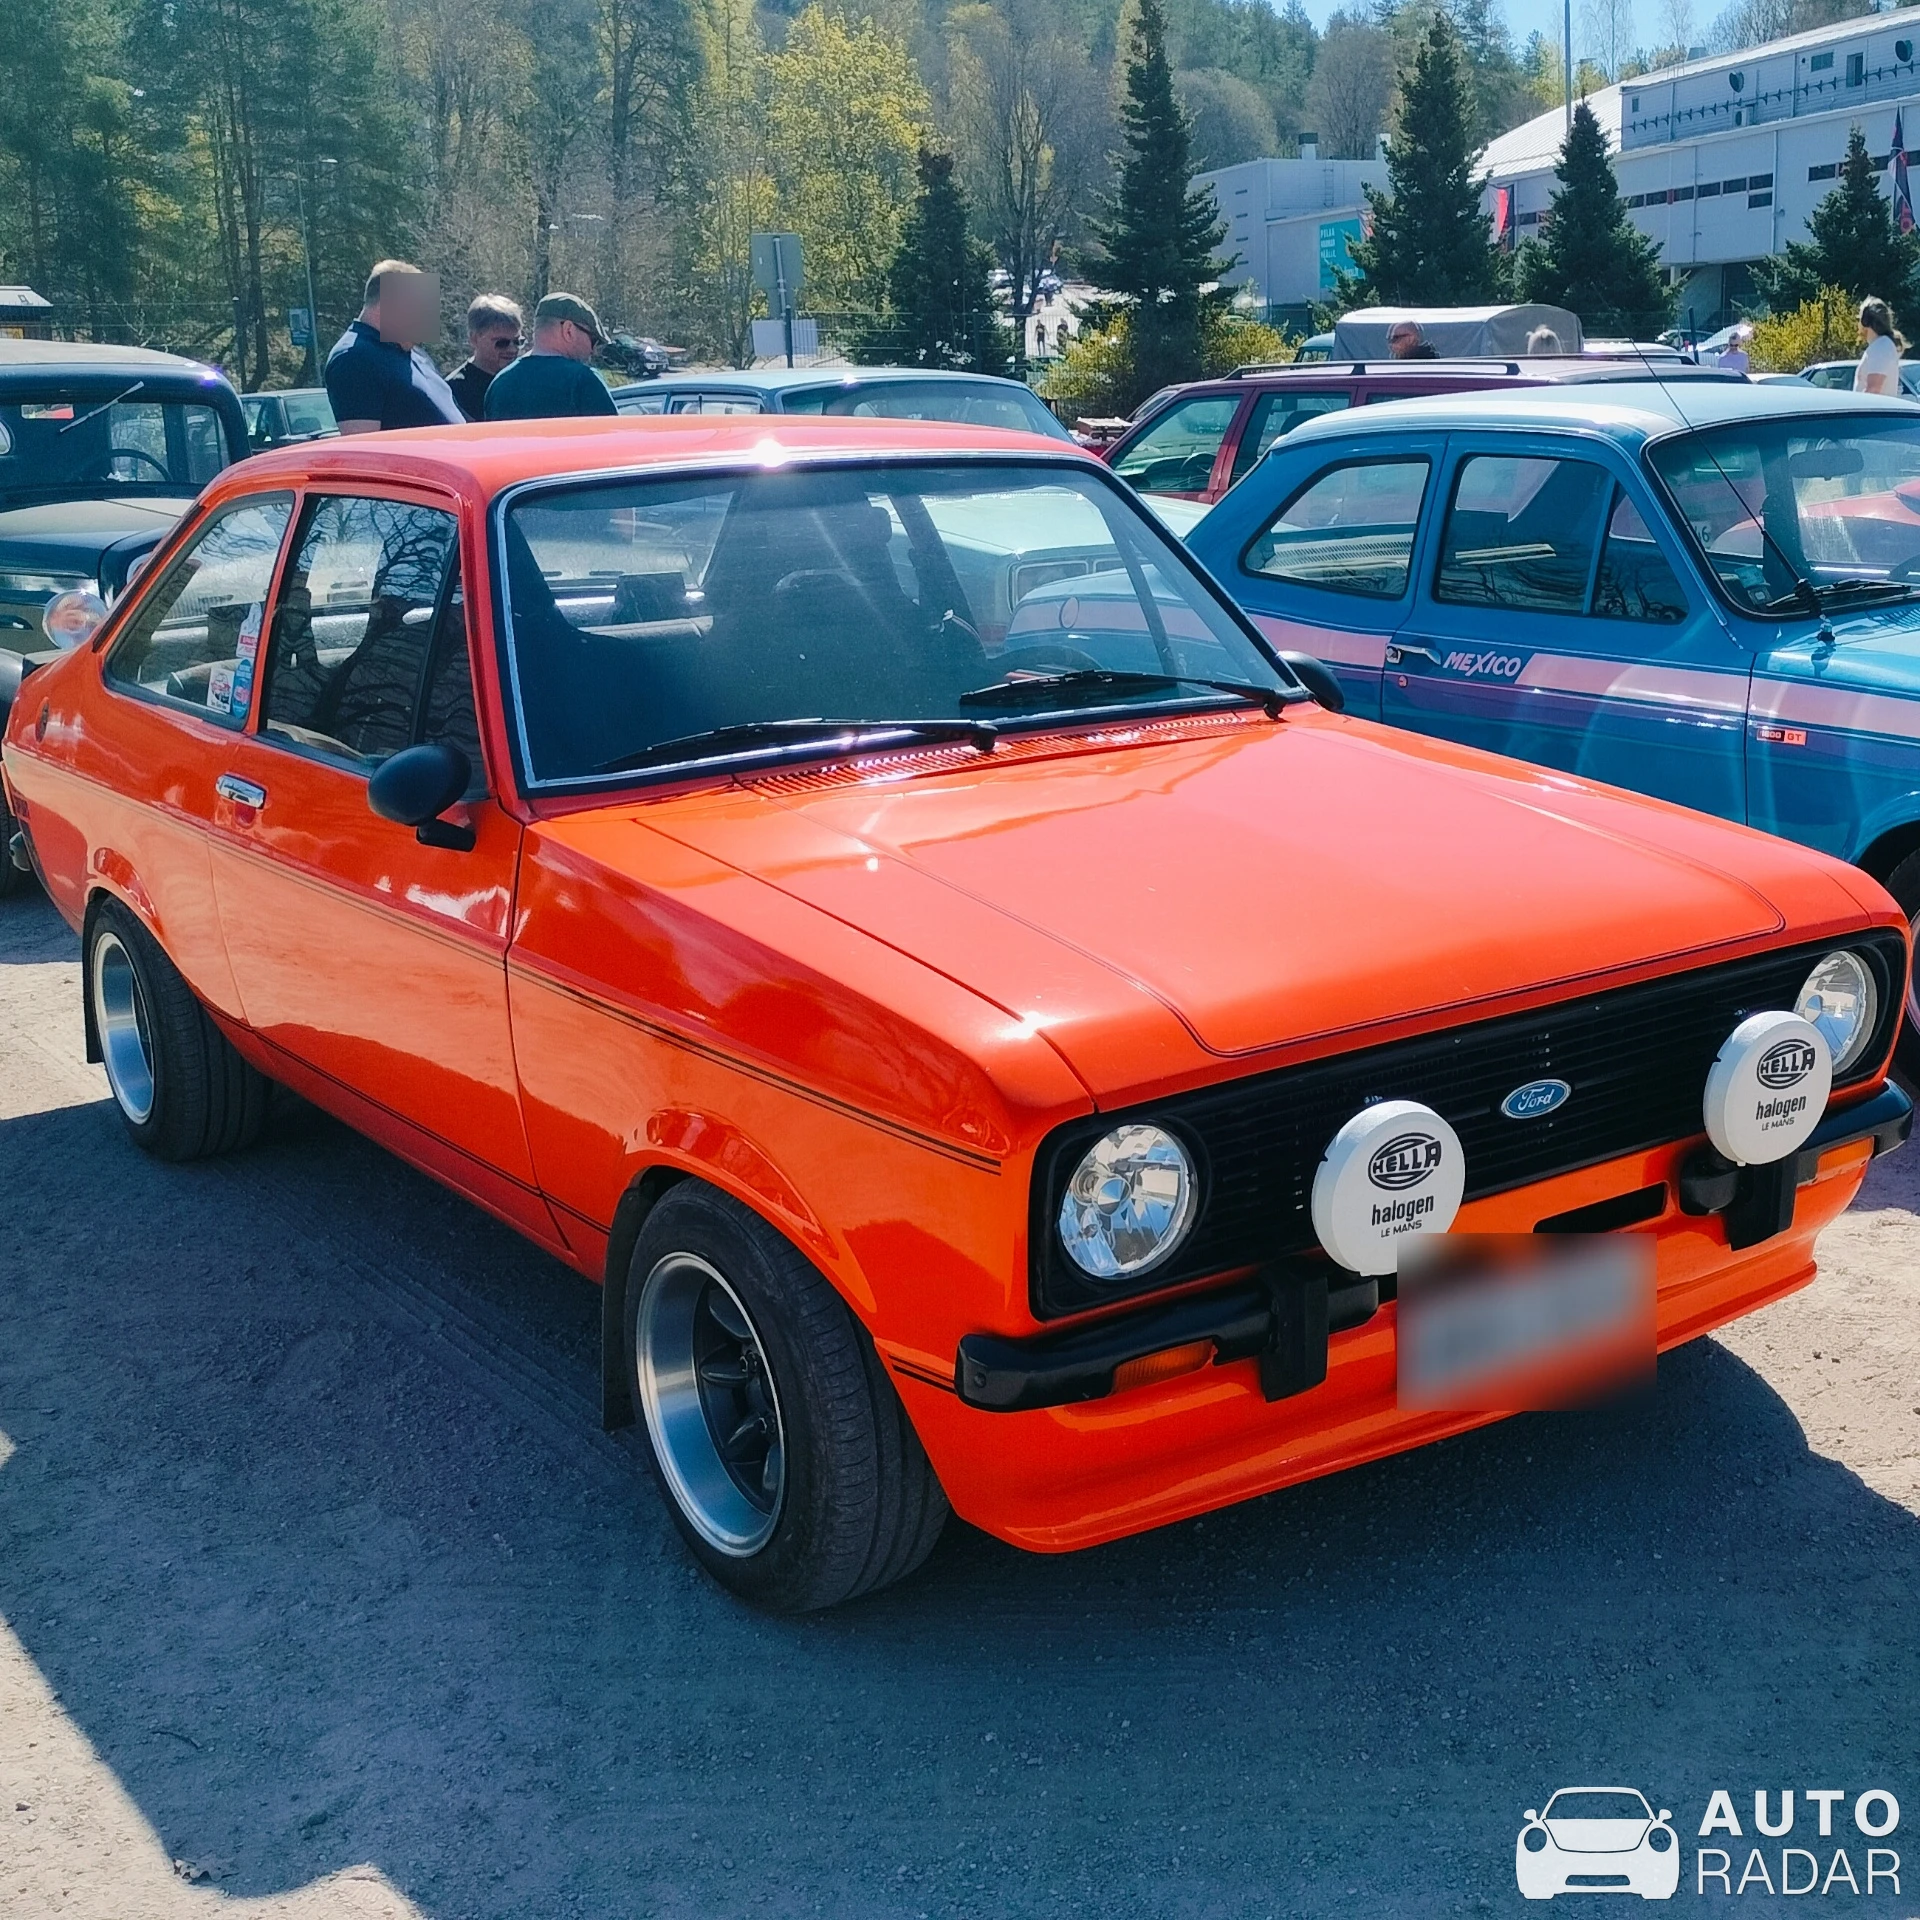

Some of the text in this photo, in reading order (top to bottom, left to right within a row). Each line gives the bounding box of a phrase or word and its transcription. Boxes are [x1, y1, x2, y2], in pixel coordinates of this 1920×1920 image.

[1442, 651, 1522, 677] MEXICO
[1787, 733, 1802, 742] GT
[1760, 1047, 1816, 1075] HELLA
[1518, 1086, 1556, 1111] Ford
[1755, 1095, 1807, 1120] halogen
[1761, 1117, 1796, 1131] LE MANS
[1372, 1140, 1442, 1175] HELLA
[1371, 1195, 1435, 1227] halogen
[1380, 1219, 1423, 1238] LE MANS
